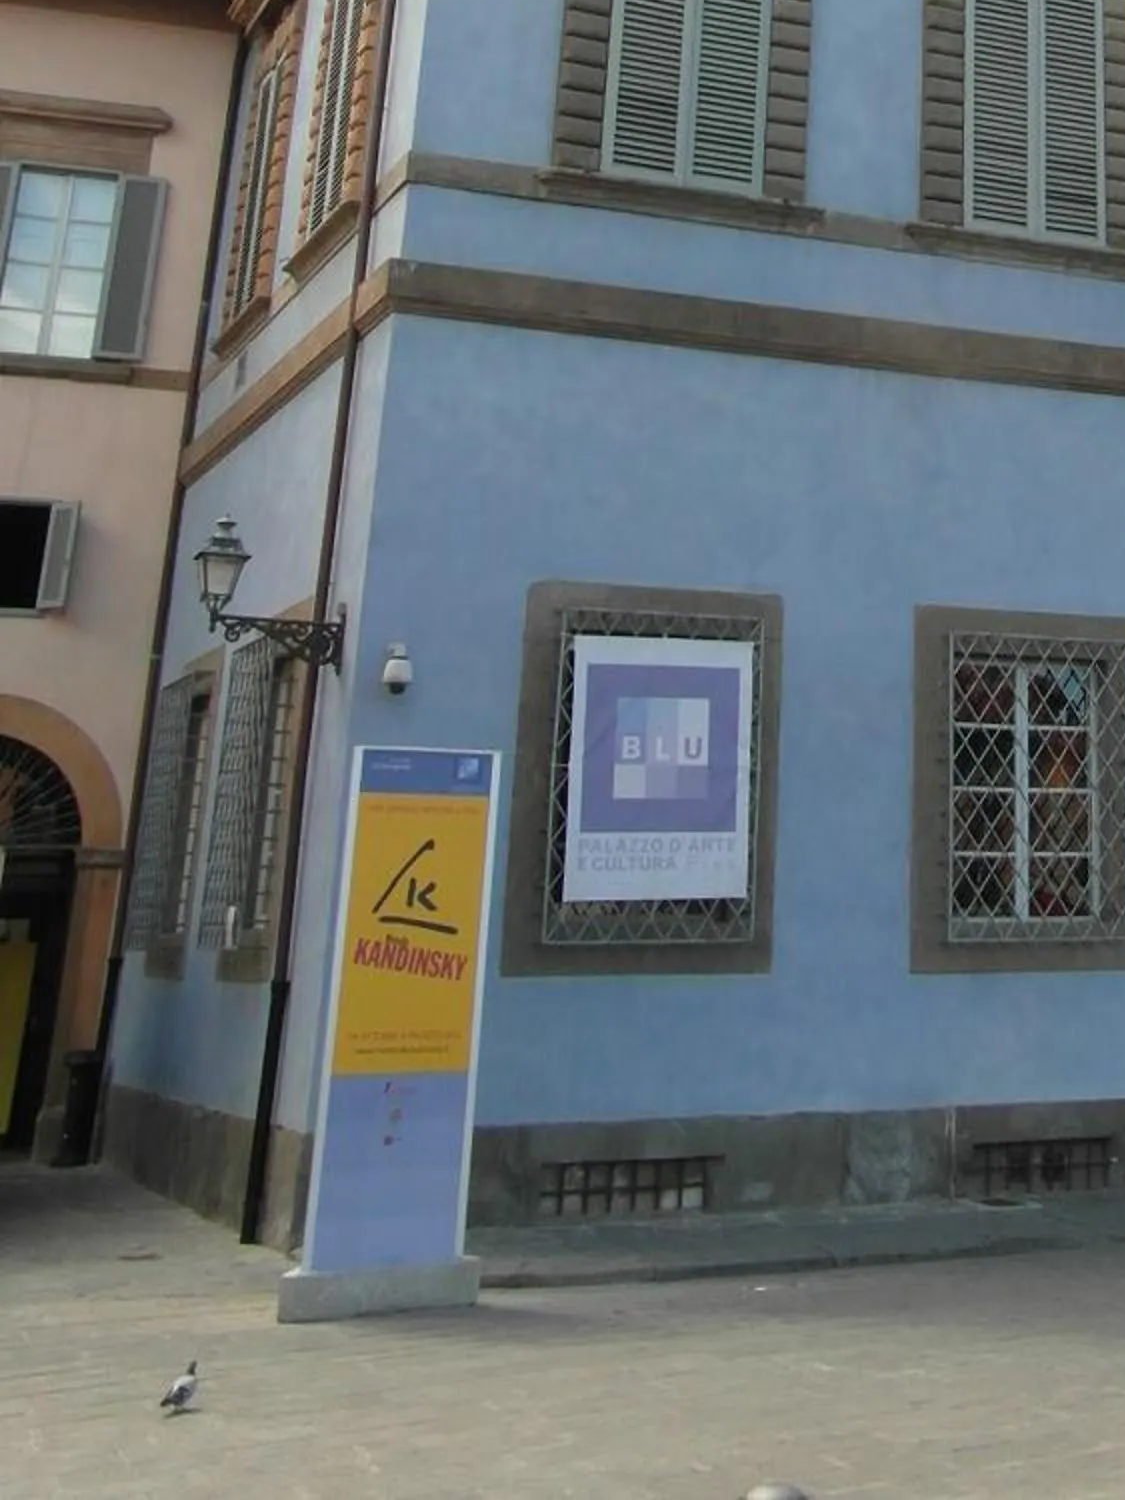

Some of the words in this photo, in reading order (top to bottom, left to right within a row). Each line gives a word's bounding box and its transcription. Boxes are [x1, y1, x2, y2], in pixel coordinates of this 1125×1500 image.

[621, 735, 702, 761] BLU
[577, 838, 664, 854] PALAZZO
[591, 855, 678, 872] CULTURA
[354, 937, 468, 981] KANDINSKY
